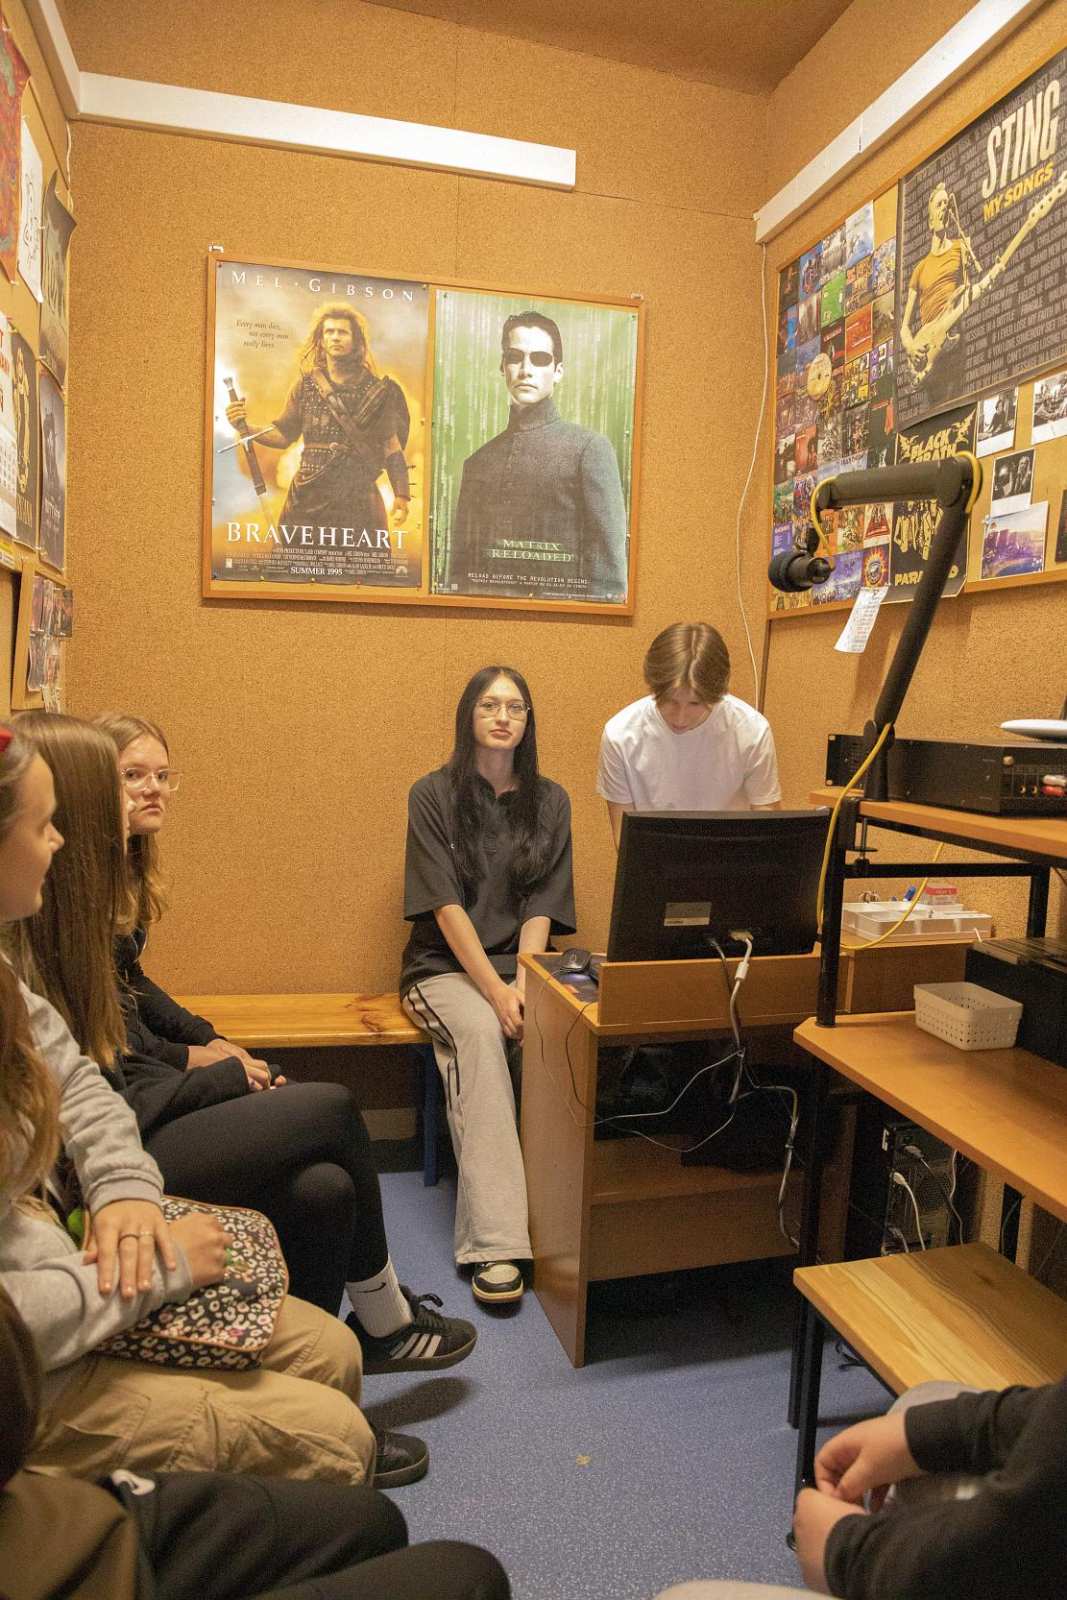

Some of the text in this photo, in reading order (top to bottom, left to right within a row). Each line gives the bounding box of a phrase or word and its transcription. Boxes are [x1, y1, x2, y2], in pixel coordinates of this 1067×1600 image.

[982, 80, 1060, 198] STING
[983, 193, 1004, 221] MY
[1004, 162, 1055, 208] SONGS
[231, 270, 414, 301] MEL GIBSON
[227, 522, 408, 549] BRAVEHEART
[503, 539, 560, 551] MATRIX
[492, 549, 572, 562] RELOADED
[291, 566, 343, 576] SUMMER 1995
